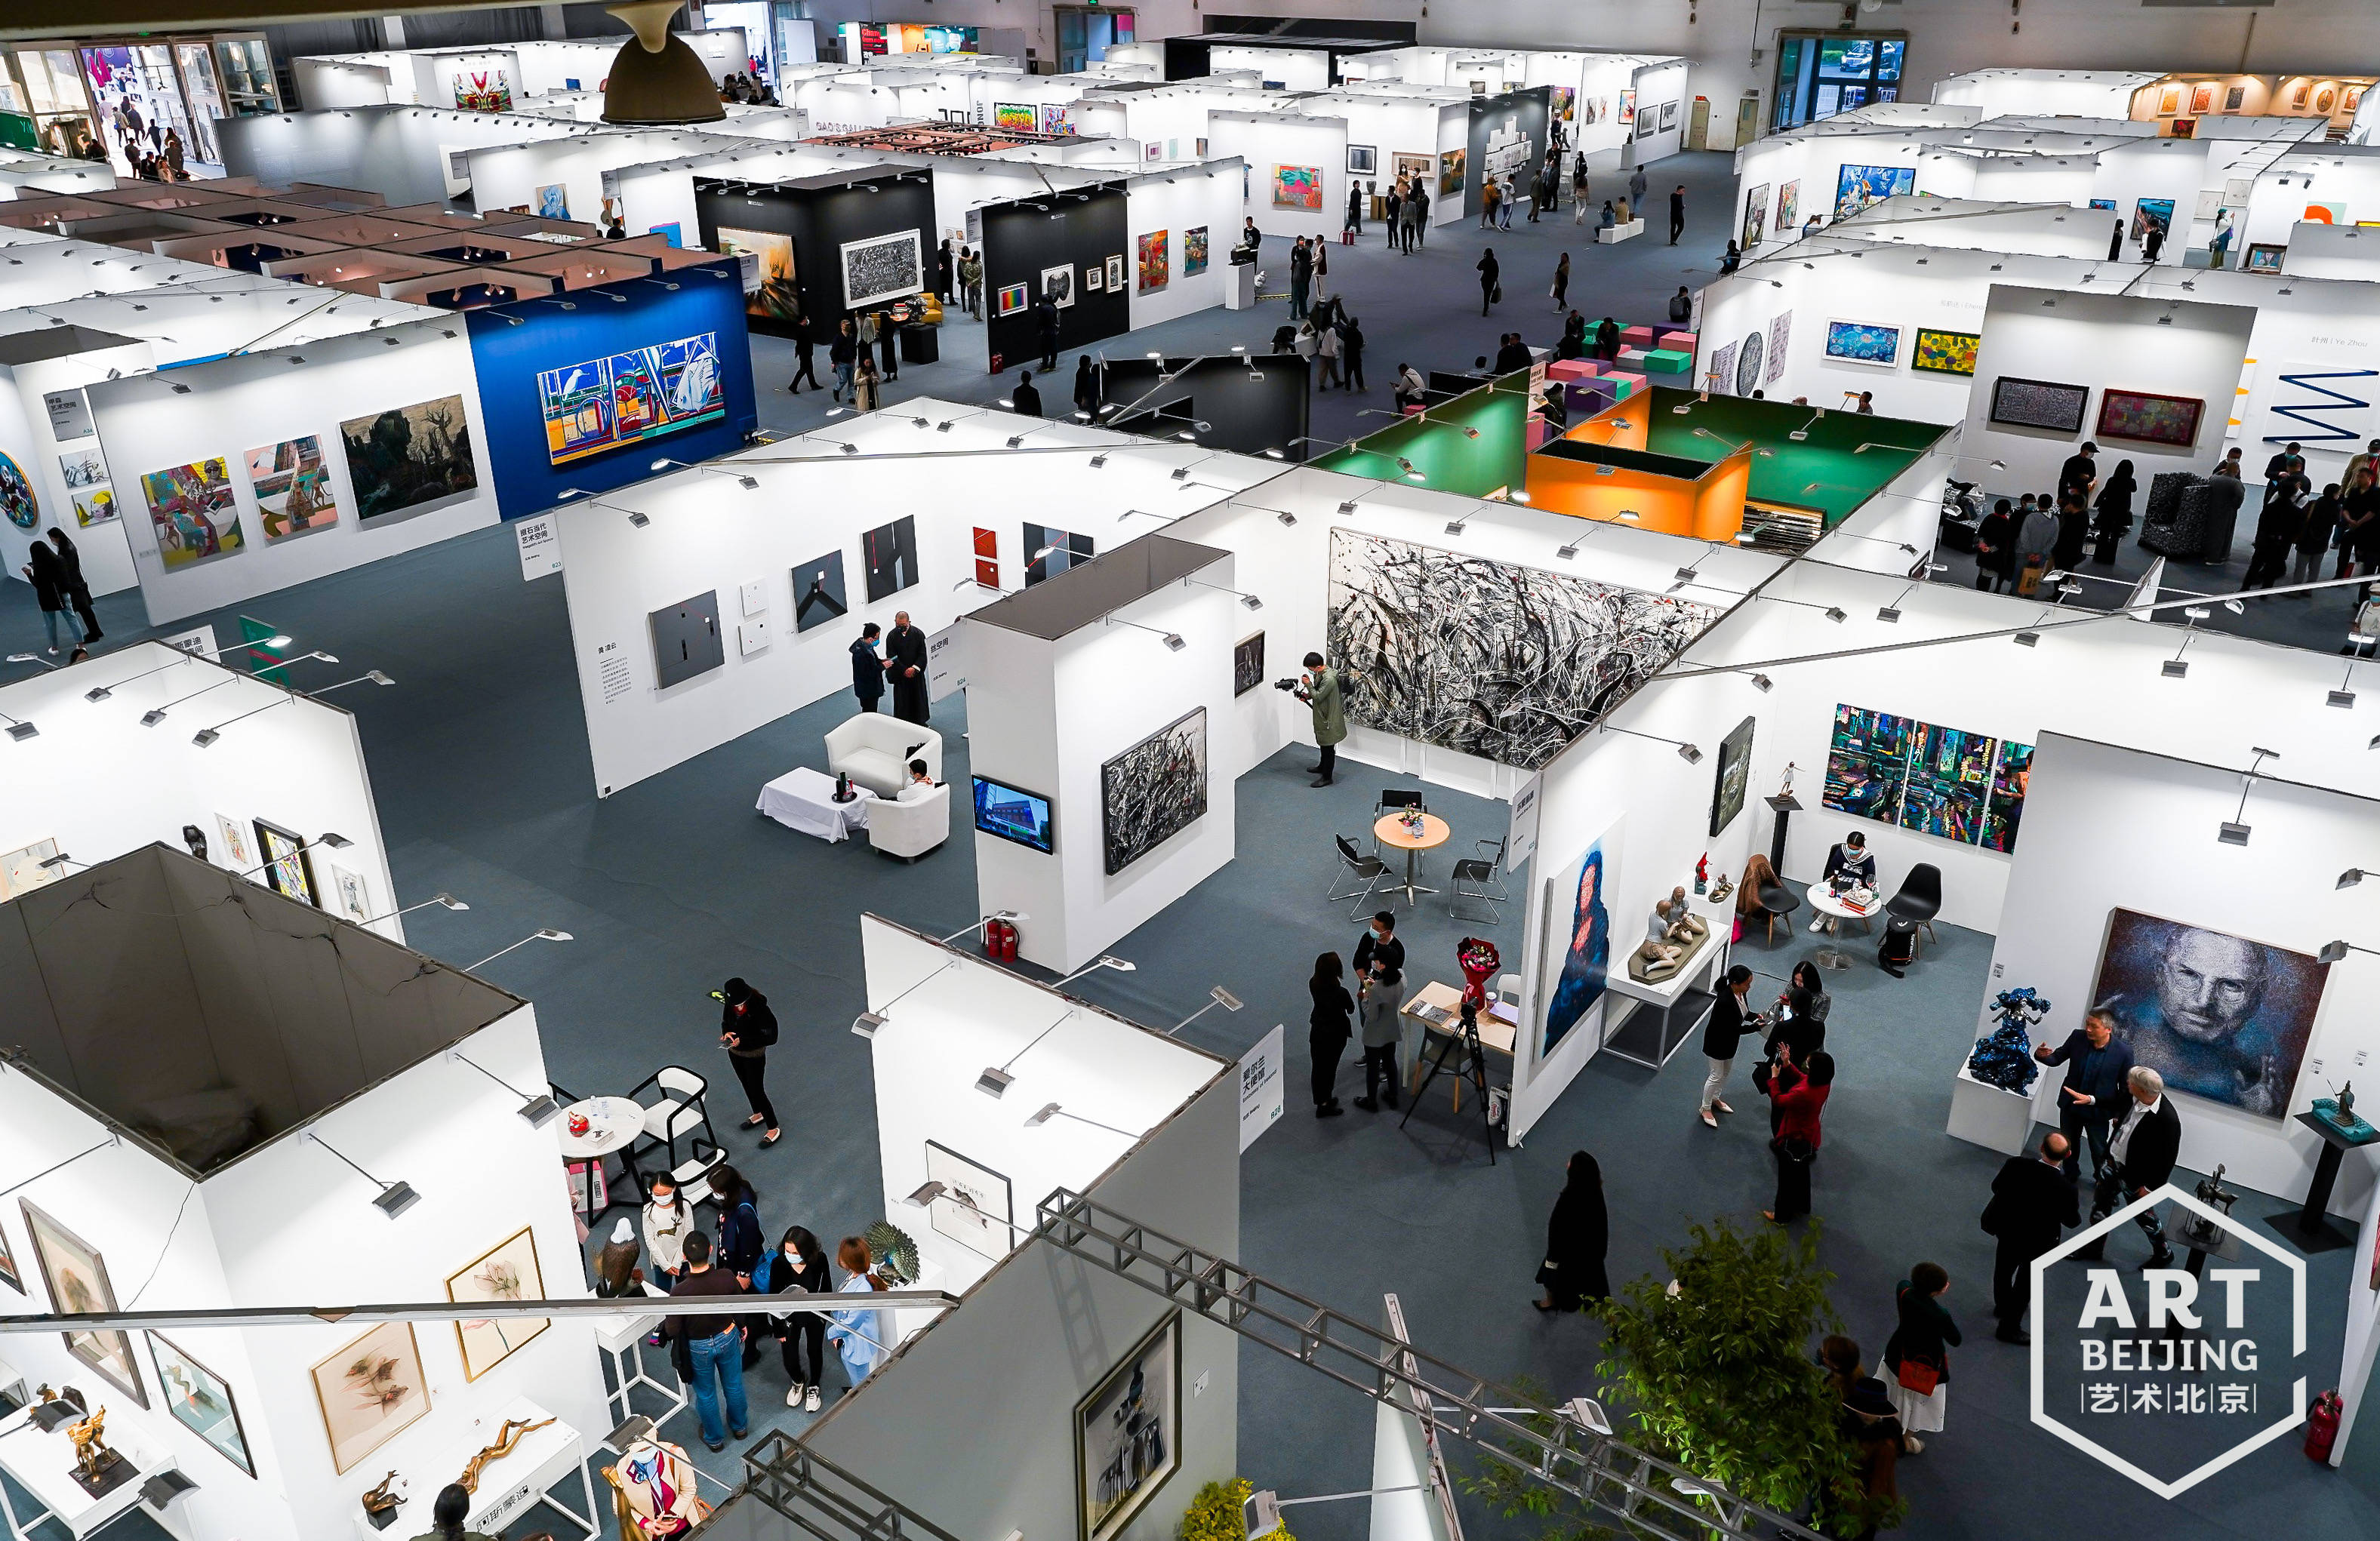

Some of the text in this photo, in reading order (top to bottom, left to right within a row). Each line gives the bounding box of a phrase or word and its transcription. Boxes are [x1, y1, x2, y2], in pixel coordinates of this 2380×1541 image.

[522, 530, 548, 544] 艺术空间
[172, 636, 202, 649] 斯蒙迪
[1242, 1055, 1265, 1082] 爱尔兰
[1242, 1067, 1265, 1095] 大使馆
[1270, 1105, 1281, 1120] B28
[476, 1485, 531, 1532] 阿斯蒙迪
